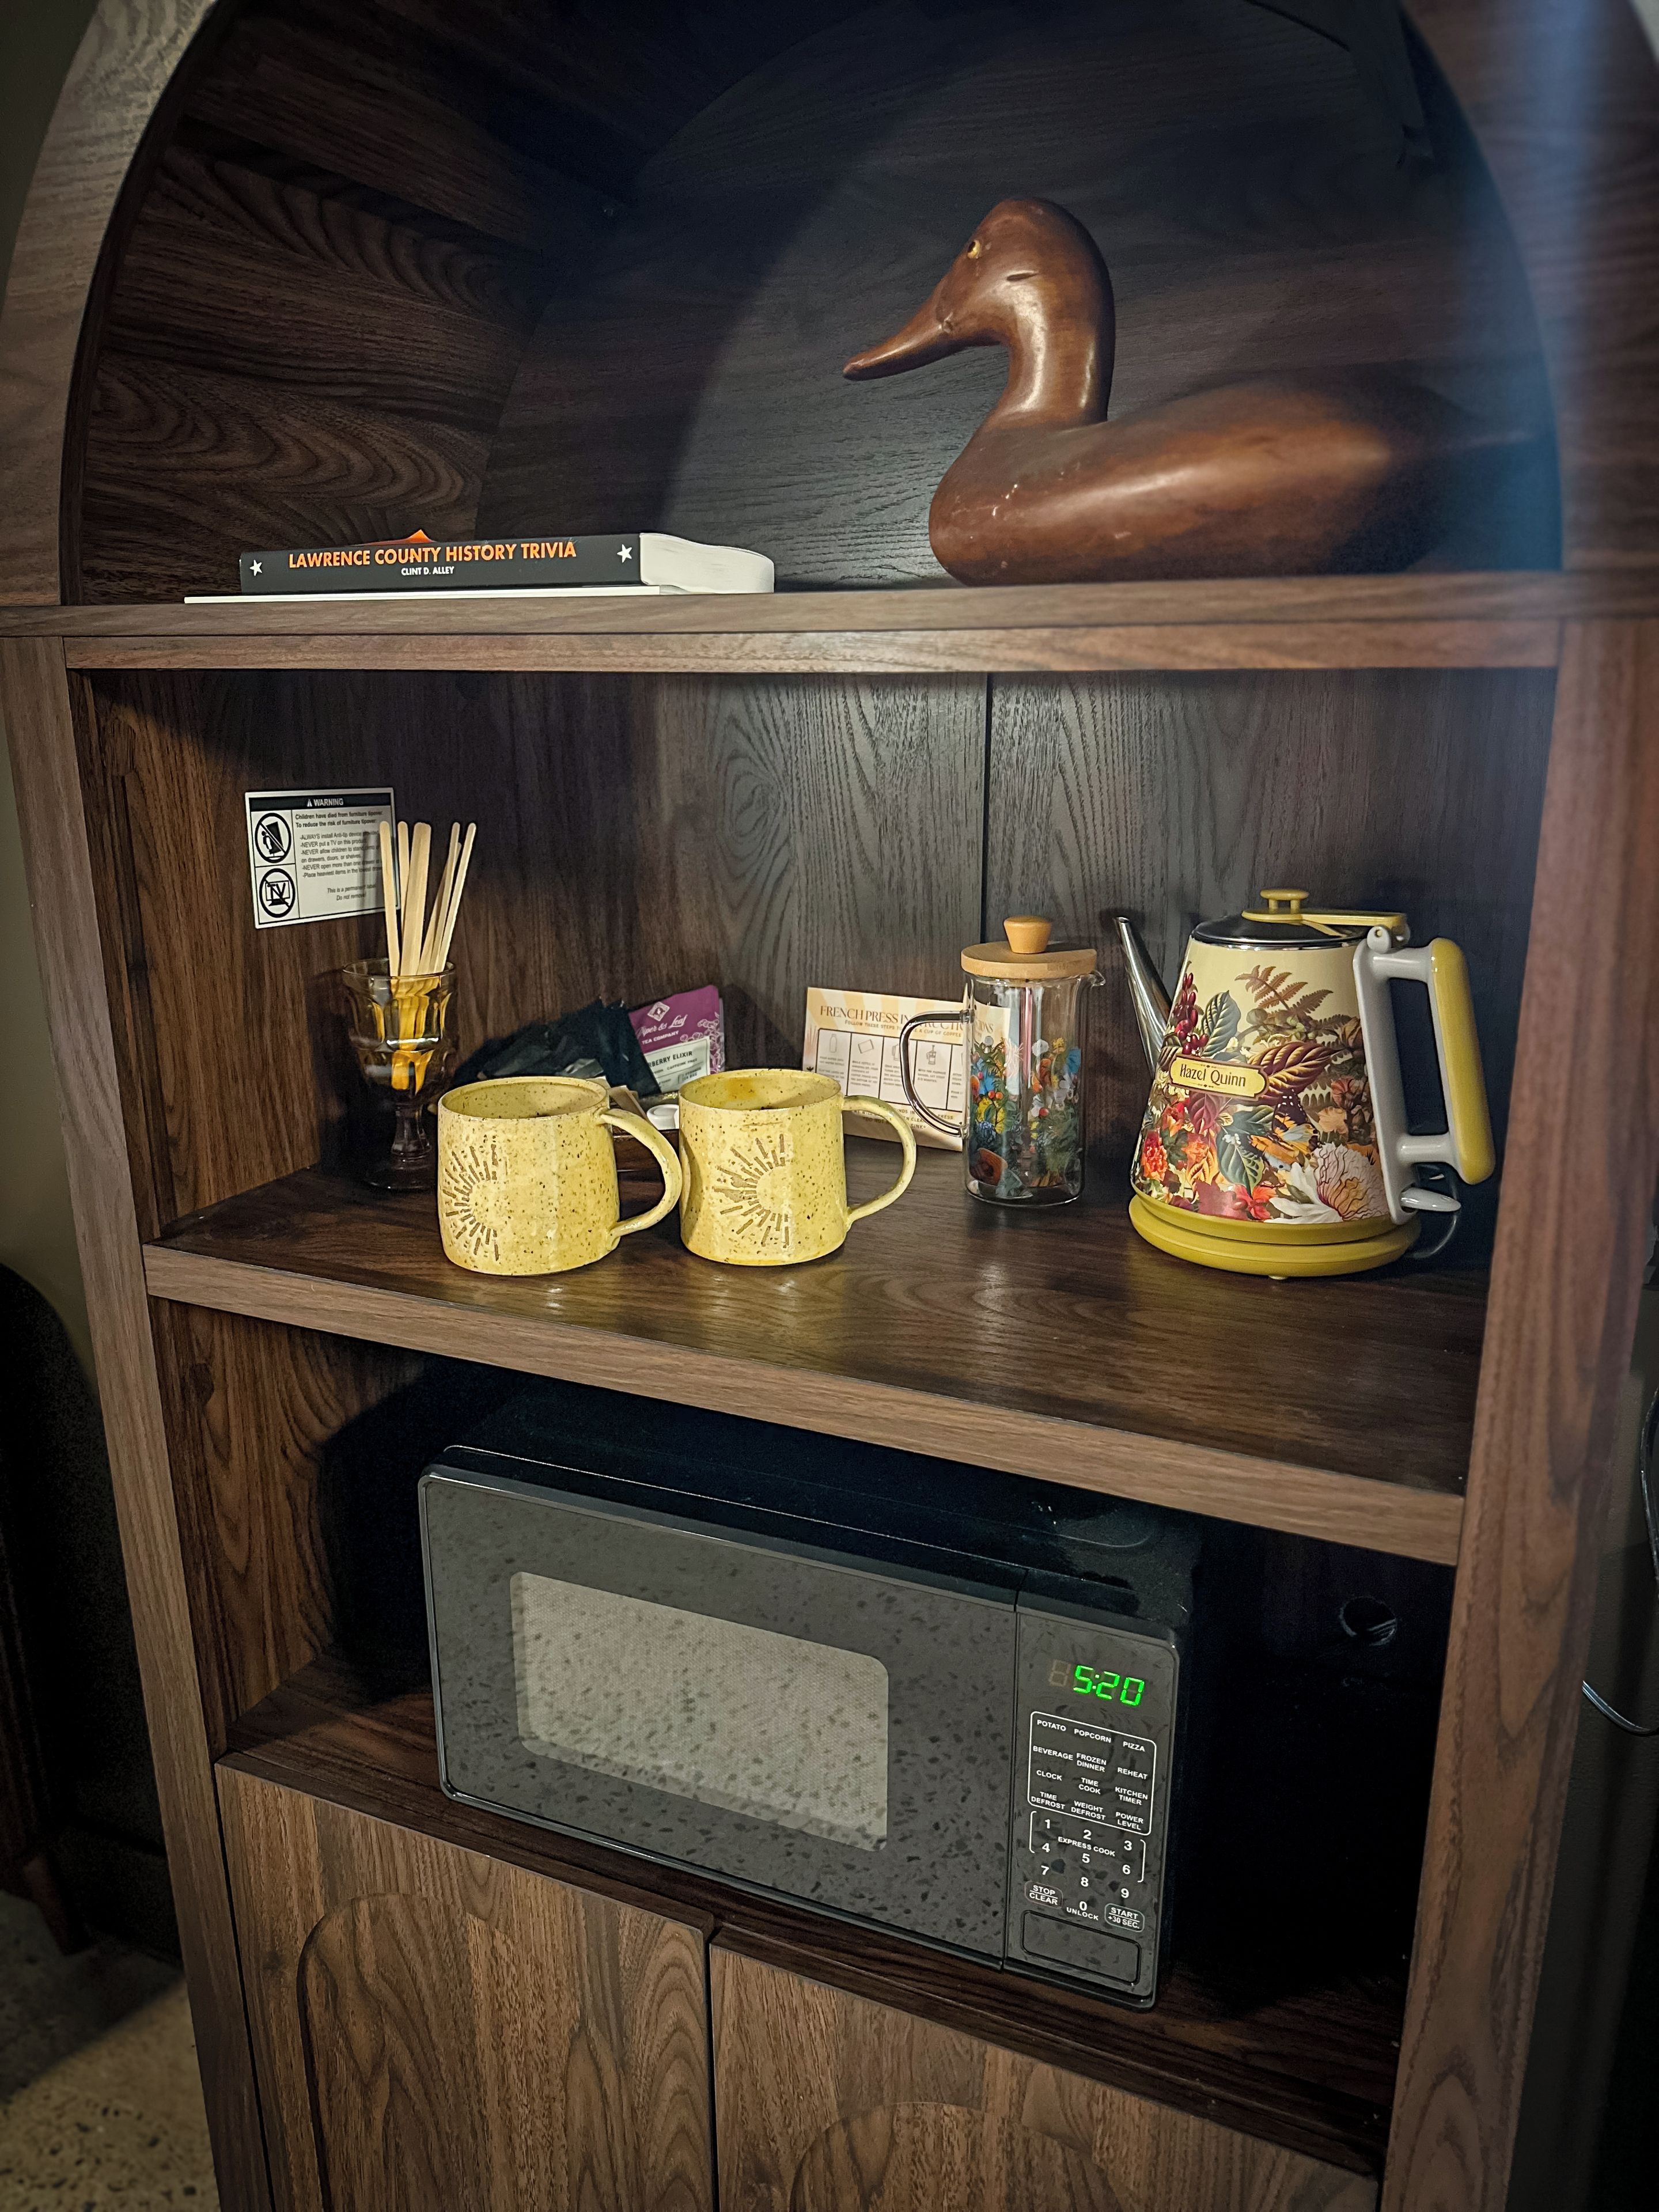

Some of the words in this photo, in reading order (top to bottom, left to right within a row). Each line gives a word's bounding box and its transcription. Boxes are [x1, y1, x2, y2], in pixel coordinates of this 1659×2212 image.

[289, 550, 370, 568] LAWRENCE
[375, 547, 441, 565] COUNTY
[446, 544, 517, 562] HISTORY
[521, 541, 576, 559] TRIVIA
[401, 567, 421, 575] CLINT
[423, 567, 431, 575] D.
[433, 566, 454, 574] ALLEY
[314, 798, 344, 806] WARNING
[820, 1006, 863, 1020] FRENCH
[866, 1010, 898, 1023] PRESS
[668, 1014, 688, 1029] Leaf
[653, 1031, 679, 1041] COMPANY
[673, 1051, 692, 1060] ELIXIR
[1180, 1064, 1206, 1081] Hazel
[1211, 1070, 1245, 1086] Quinn
[1073, 1665, 1145, 1706] 5:20
[1037, 1719, 1066, 1732] POTATO
[1074, 1729, 1111, 1743] POPCORN
[1123, 1741, 1145, 1752] PIZZA
[1033, 1745, 1073, 1760] BEVERAGE
[1077, 1753, 1107, 1765] FROZEN
[1077, 1760, 1105, 1772] DINNER
[1036, 1770, 1062, 1781] CLOCK
[1118, 1767, 1148, 1779] REHEAT
[1081, 1777, 1099, 1786] TIME
[1078, 1784, 1101, 1794] COOK
[1115, 1786, 1148, 1800] KITCHEN
[1040, 1791, 1057, 1801] TIME
[1119, 1794, 1142, 1805] TIMER
[1031, 1796, 1065, 1809] DEFROST
[1074, 1801, 1103, 1813] WEIGHT
[1071, 1807, 1106, 1820] DEFROST
[1116, 1812, 1143, 1824] POWER
[1044, 1819, 1051, 1829] 1
[1117, 1820, 1141, 1830] LEVEL
[1083, 1829, 1092, 1840] 2
[1042, 1843, 1050, 1853] 4
[1058, 1836, 1092, 1850] EXPRESS
[1093, 1846, 1115, 1857] COOK
[1124, 1840, 1132, 1851] 3
[1082, 1853, 1090, 1863] 5
[1041, 1865, 1049, 1875] 7
[1122, 1865, 1131, 1875] 6
[1081, 1877, 1089, 1887] 8
[1033, 1885, 1055, 1895] STOP
[1121, 1888, 1129, 1898] 9
[1029, 1893, 1058, 1906] CLEAR
[1079, 1901, 1088, 1911] 0
[1066, 1907, 1099, 1921] UNLOCK
[1111, 1907, 1138, 1920] START
[1108, 1915, 1121, 1923] +30
[1122, 1919, 1140, 1929] SEC.
